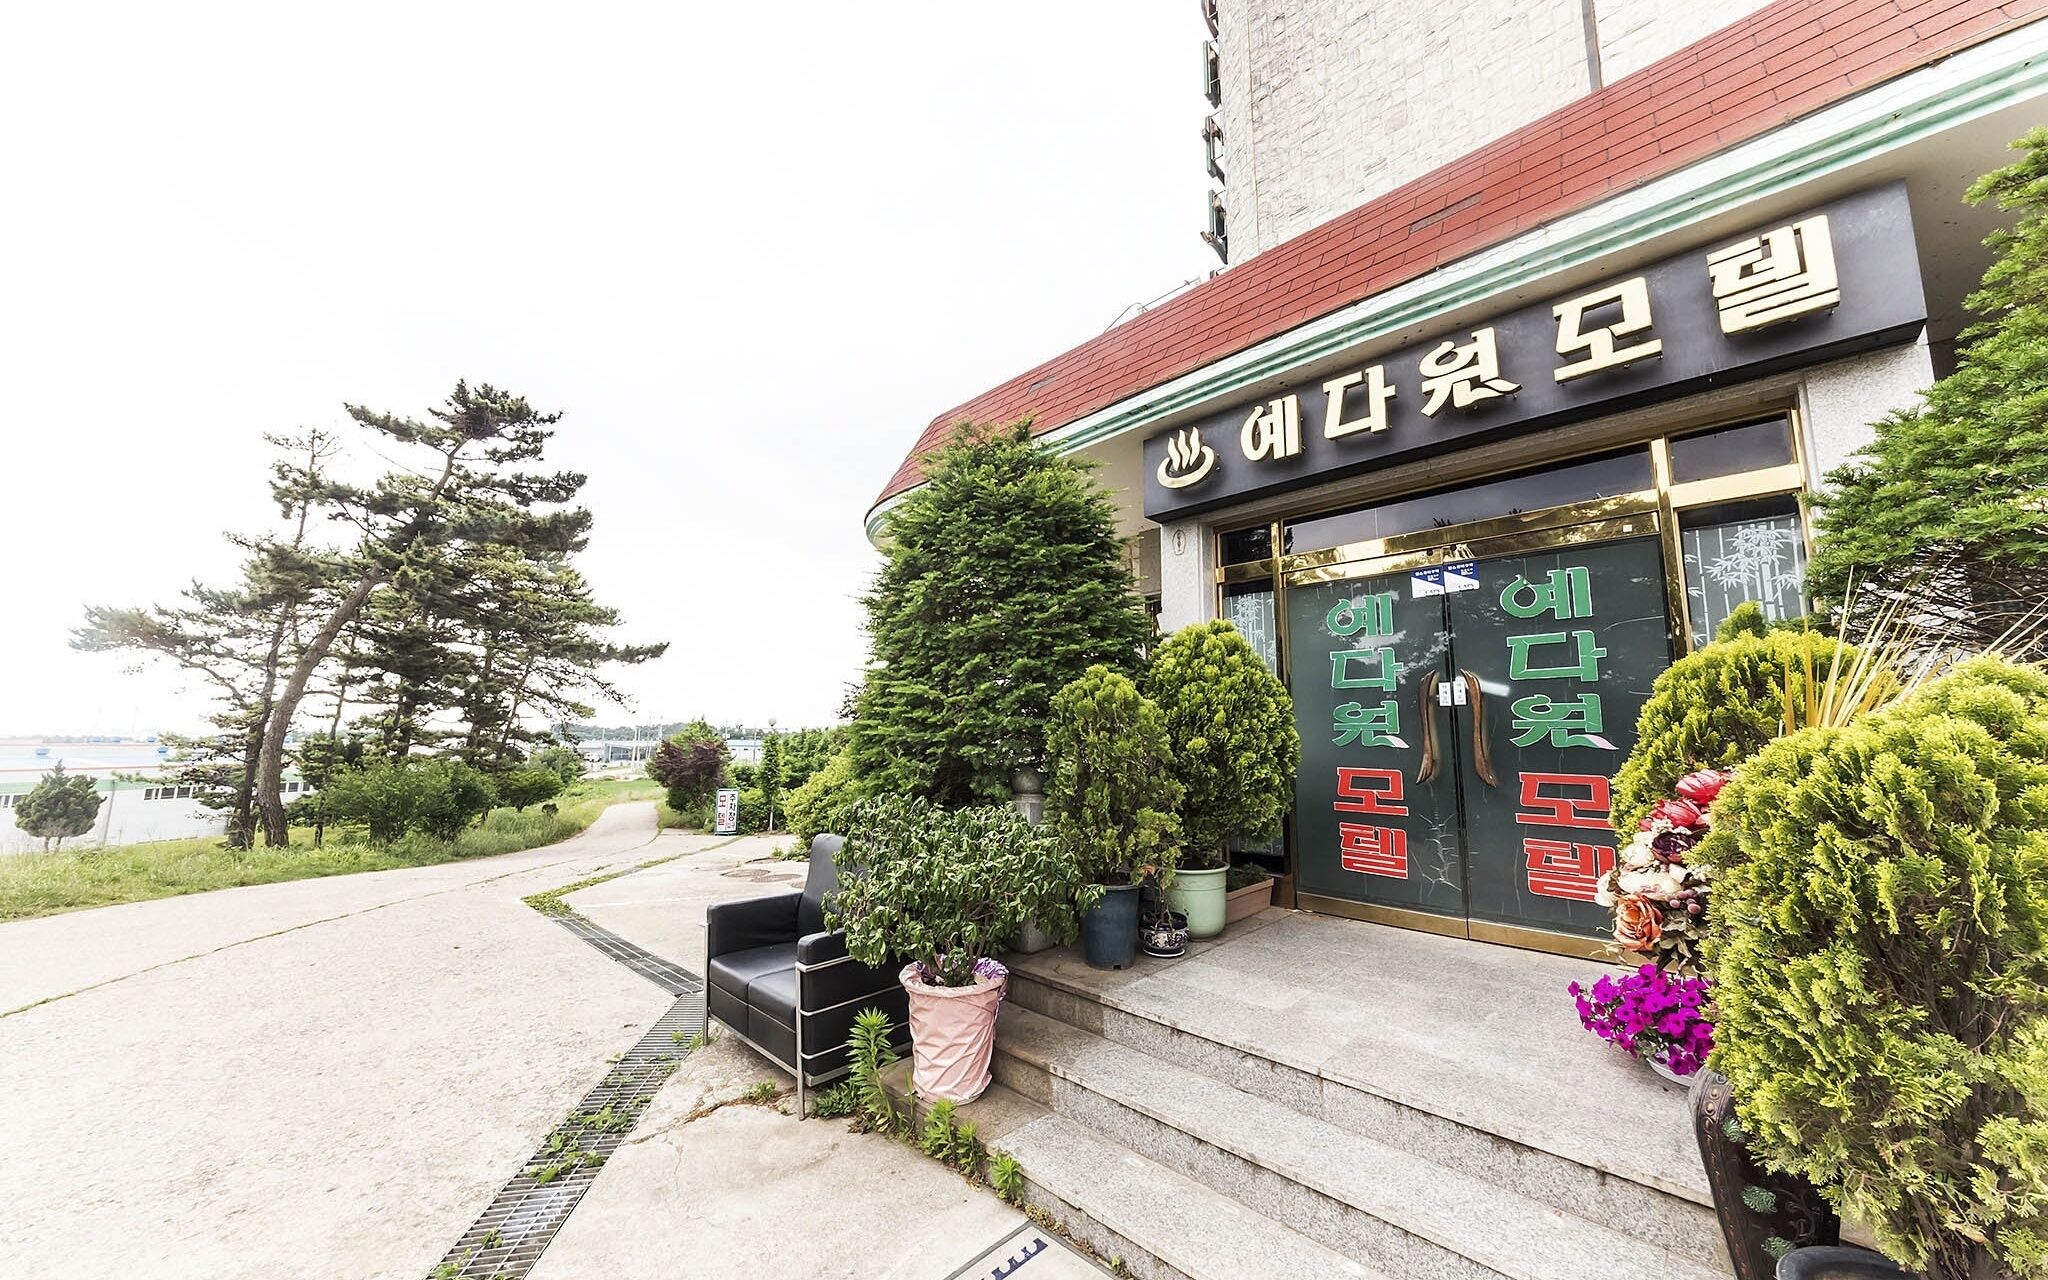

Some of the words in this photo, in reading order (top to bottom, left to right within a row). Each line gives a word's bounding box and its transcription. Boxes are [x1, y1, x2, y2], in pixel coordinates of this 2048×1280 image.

[1240, 326, 1522, 462] 예다원
[1552, 214, 1841, 383] 모텔
[1326, 592, 1410, 749] 예다원
[1499, 566, 1619, 751] 예다원
[1333, 766, 1409, 880] 모텔
[1515, 771, 1617, 902] 모텔
